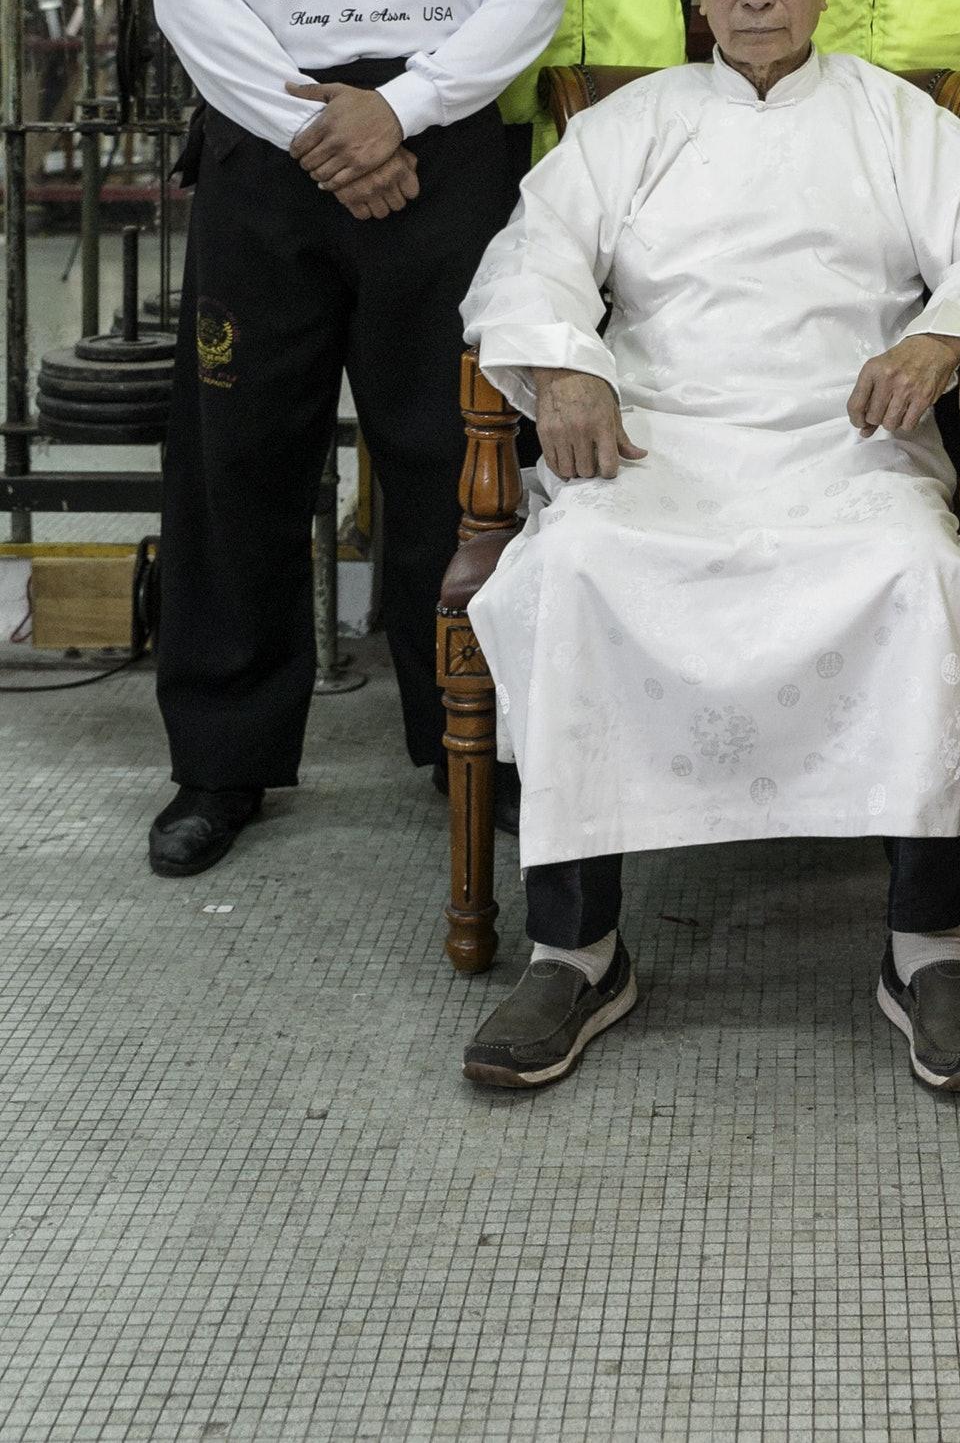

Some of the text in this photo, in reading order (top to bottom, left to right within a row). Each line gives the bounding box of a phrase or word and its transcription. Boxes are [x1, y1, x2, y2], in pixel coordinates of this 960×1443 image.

[289, 9, 331, 27] Kung
[338, 8, 364, 23] Fu
[422, 6, 453, 22] USA
